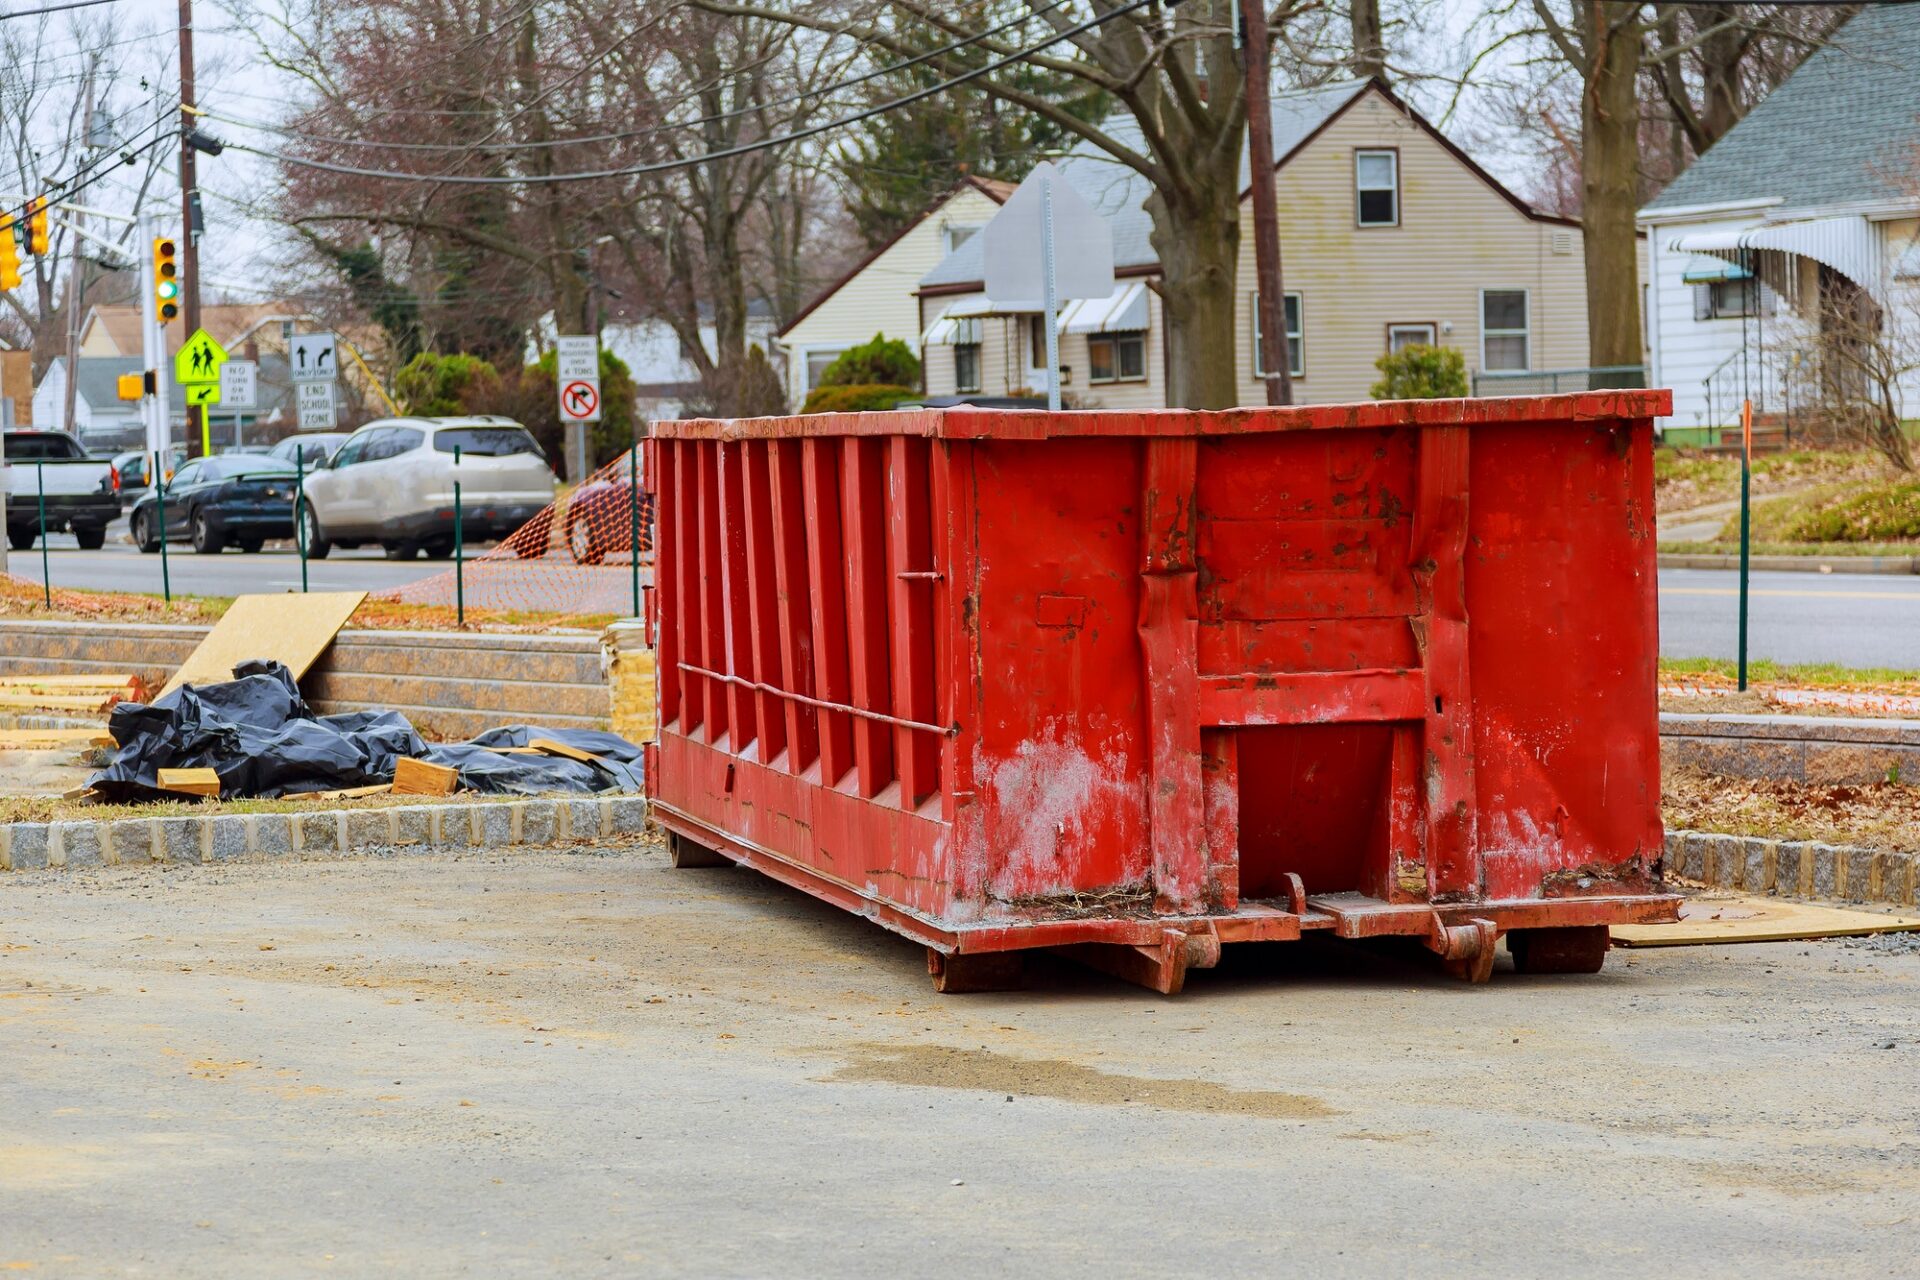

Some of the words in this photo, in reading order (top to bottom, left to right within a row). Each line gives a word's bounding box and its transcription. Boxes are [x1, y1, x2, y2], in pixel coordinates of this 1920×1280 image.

[316, 368, 335, 376] ONLY
[305, 386, 326, 395] END
[302, 400, 330, 410] SCHOOL
[305, 414, 329, 424] ZONE
